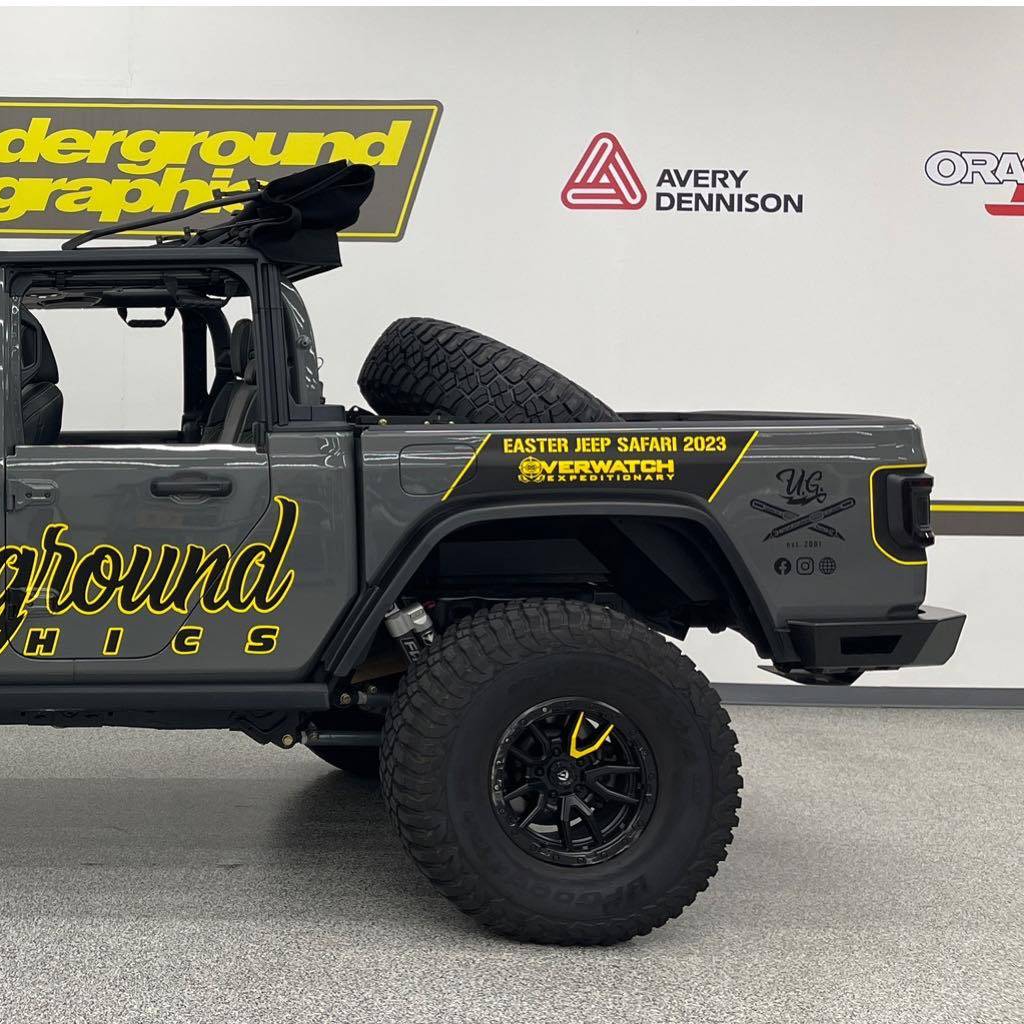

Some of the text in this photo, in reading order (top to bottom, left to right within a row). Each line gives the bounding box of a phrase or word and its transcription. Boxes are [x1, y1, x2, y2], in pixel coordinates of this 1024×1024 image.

[924, 150, 1024, 186] ORA
[656, 169, 749, 189] AVERY
[655, 192, 804, 213] DENNISON
[503, 435, 727, 454] EASTER JEEP SAFARI 2023
[547, 474, 675, 482] EXPEDITIONARY
